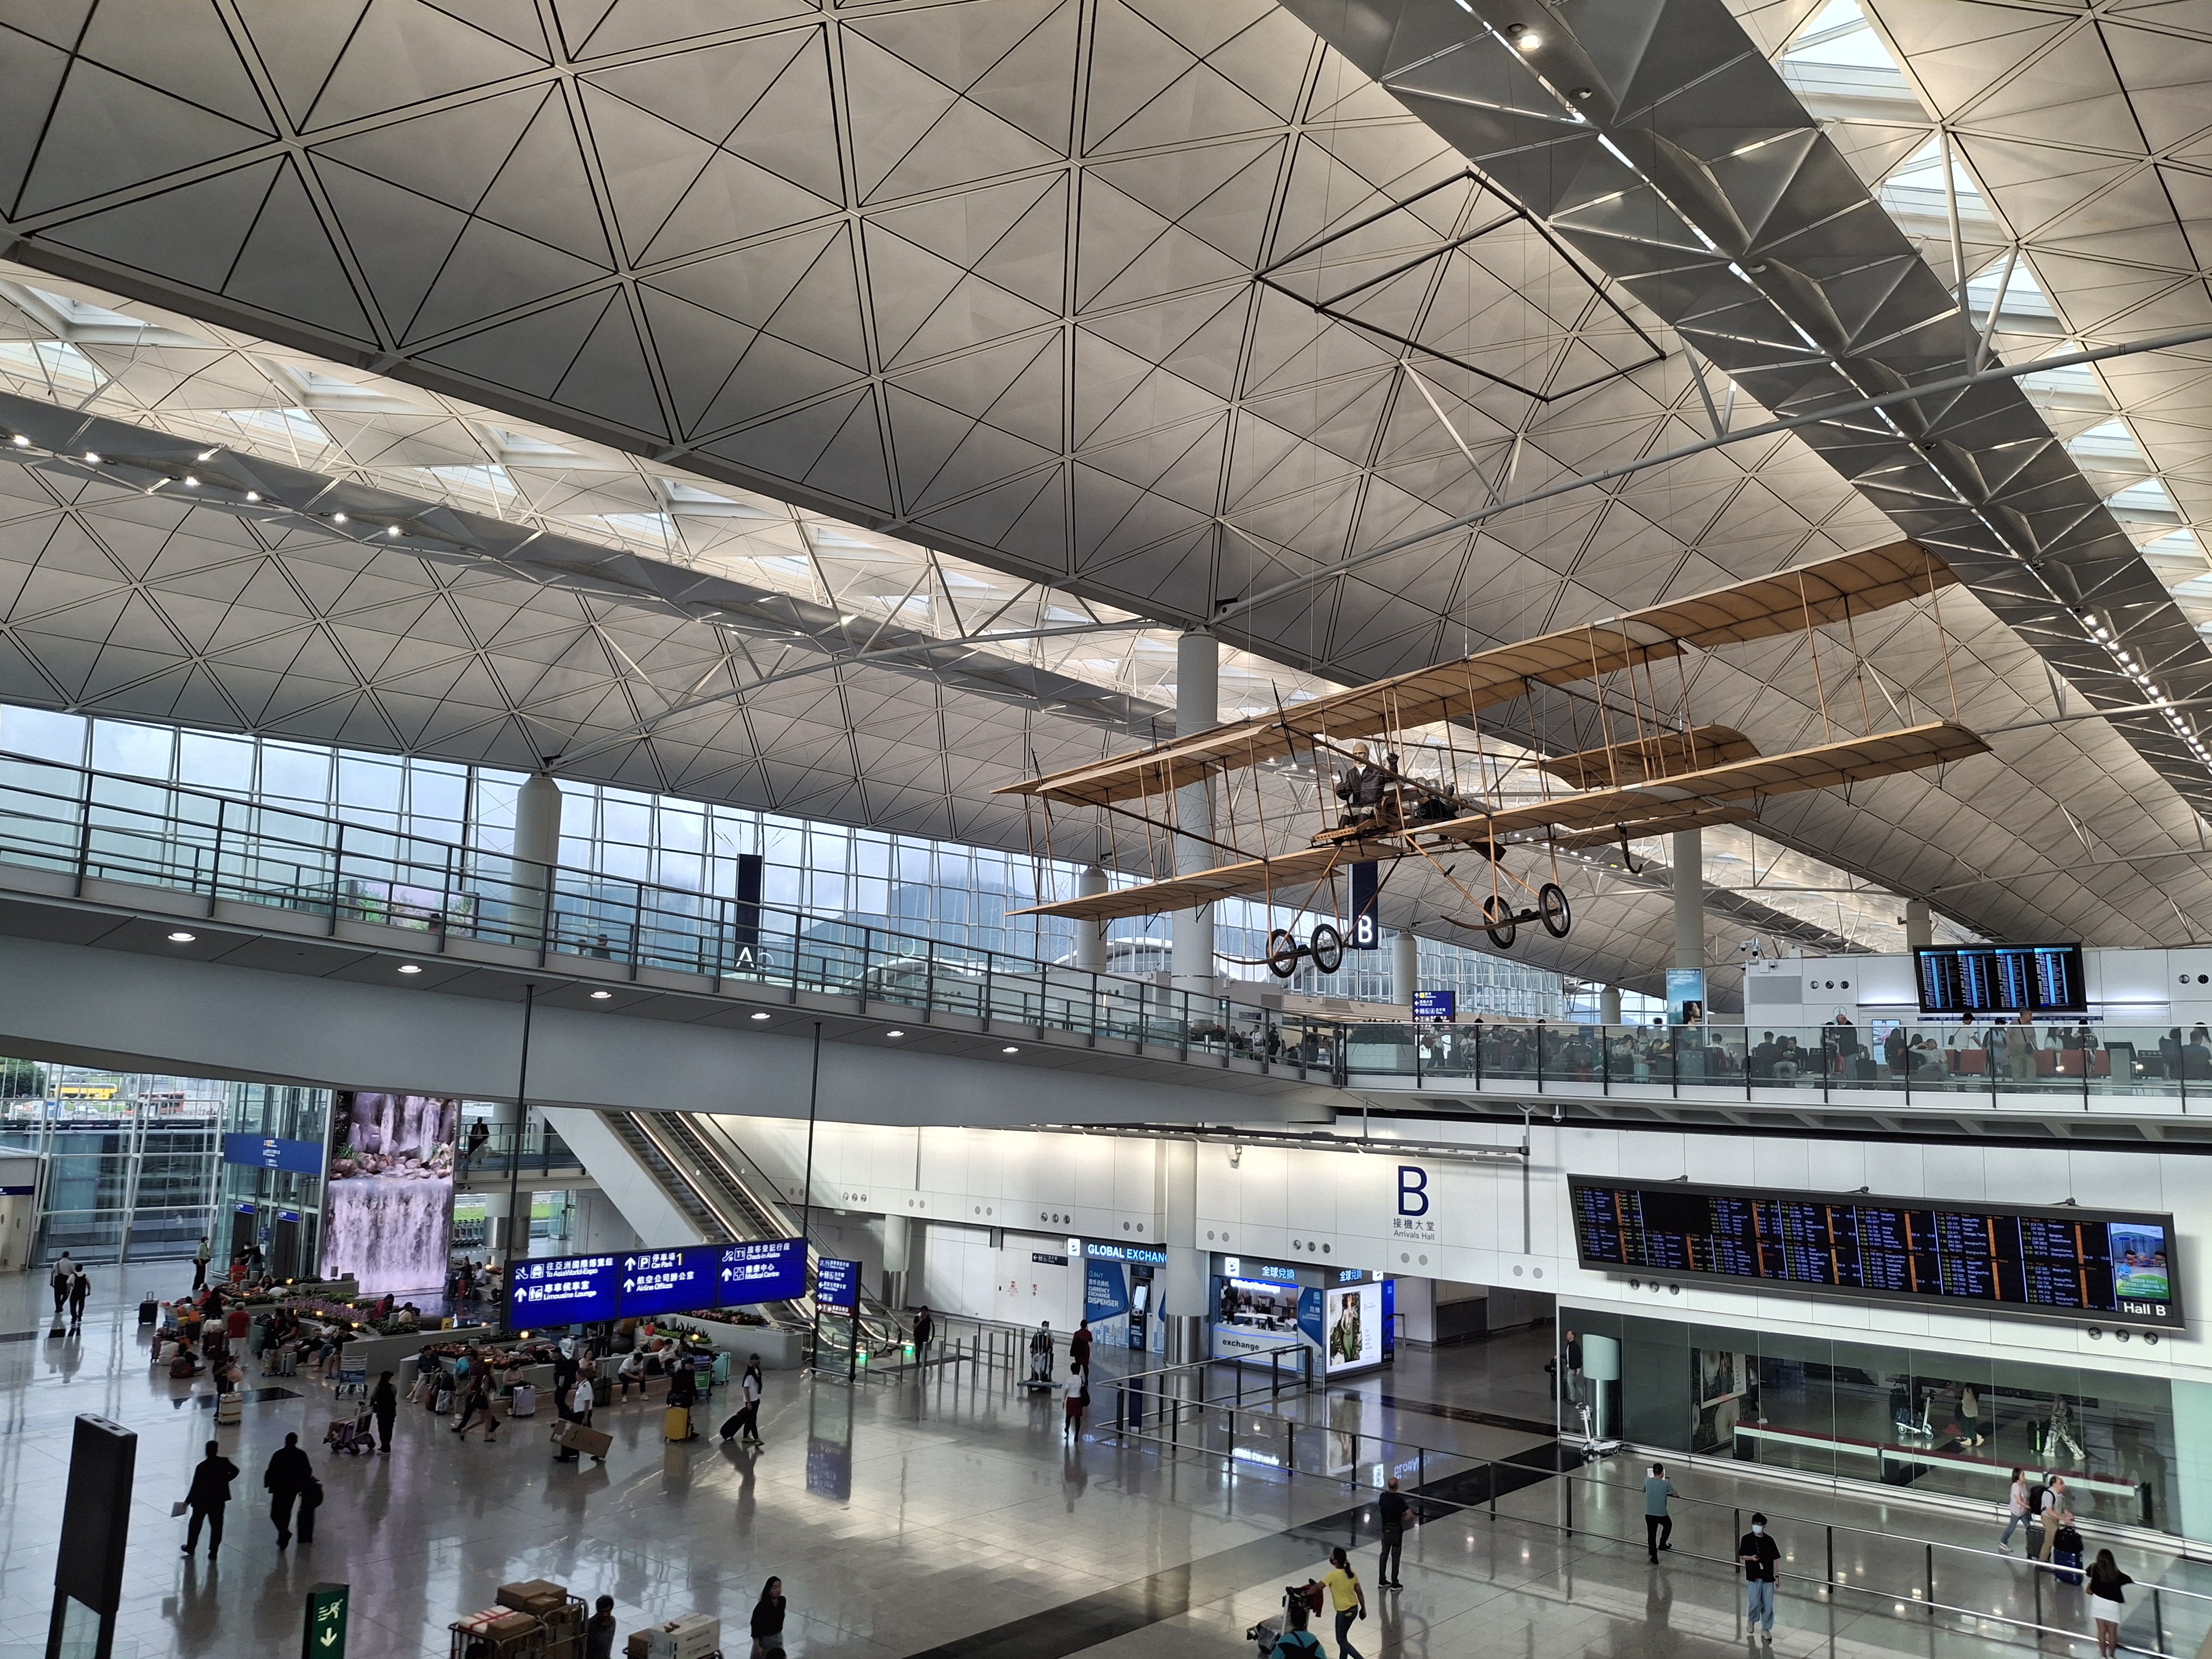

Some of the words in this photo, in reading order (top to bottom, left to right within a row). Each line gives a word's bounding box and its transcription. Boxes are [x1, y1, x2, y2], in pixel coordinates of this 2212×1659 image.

[1358, 915, 1372, 943] B
[736, 947, 755, 968] A
[1398, 1165, 1429, 1217] B
[1393, 1217, 1435, 1232] 接機大堂
[1393, 1230, 1419, 1239] Arrivals
[1422, 1232, 1435, 1240] Hall
[652, 1252, 676, 1262] 停車場
[1088, 1244, 1125, 1258] GLOBAL
[1126, 1249, 1167, 1263] EXCHAN
[553, 1268, 599, 1277] AsiaWorld-Expo
[636, 1271, 695, 1285] 航空公司辦公室
[745, 1272, 763, 1280] Medical
[543, 1292, 574, 1301] Limousine
[1088, 1297, 1118, 1307] DISPENSER
[2123, 1302, 2151, 1315] Hall
[2156, 1304, 2166, 1316] B
[1223, 1339, 1259, 1351] exchange
